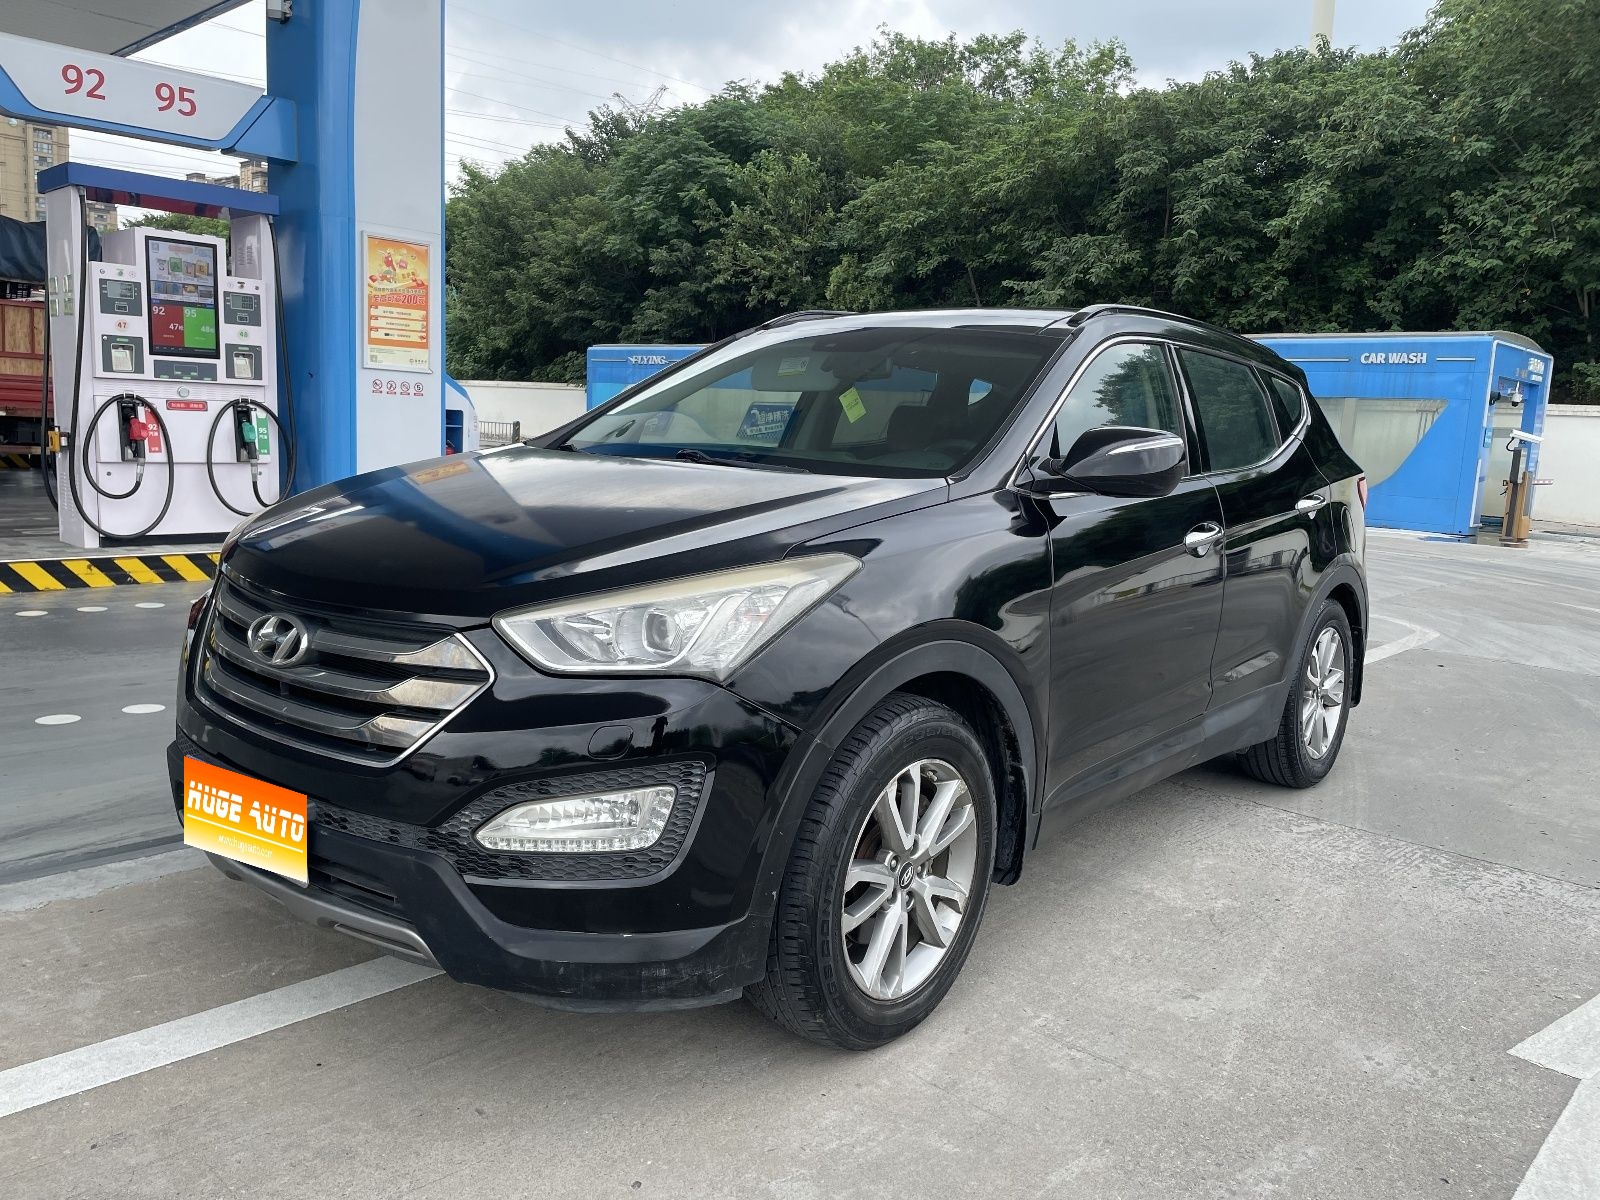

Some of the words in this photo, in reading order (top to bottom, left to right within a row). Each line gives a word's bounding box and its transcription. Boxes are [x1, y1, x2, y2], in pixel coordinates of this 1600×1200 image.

[61, 64, 105, 100] 92
[155, 82, 197, 117] 95
[152, 305, 166, 316] 92
[184, 308, 197, 318] 95
[117, 321, 127, 329] 47
[628, 355, 669, 365] FLYING
[1360, 352, 1386, 364] CAR
[1388, 352, 1428, 364] WASH
[147, 423, 159, 431] 92
